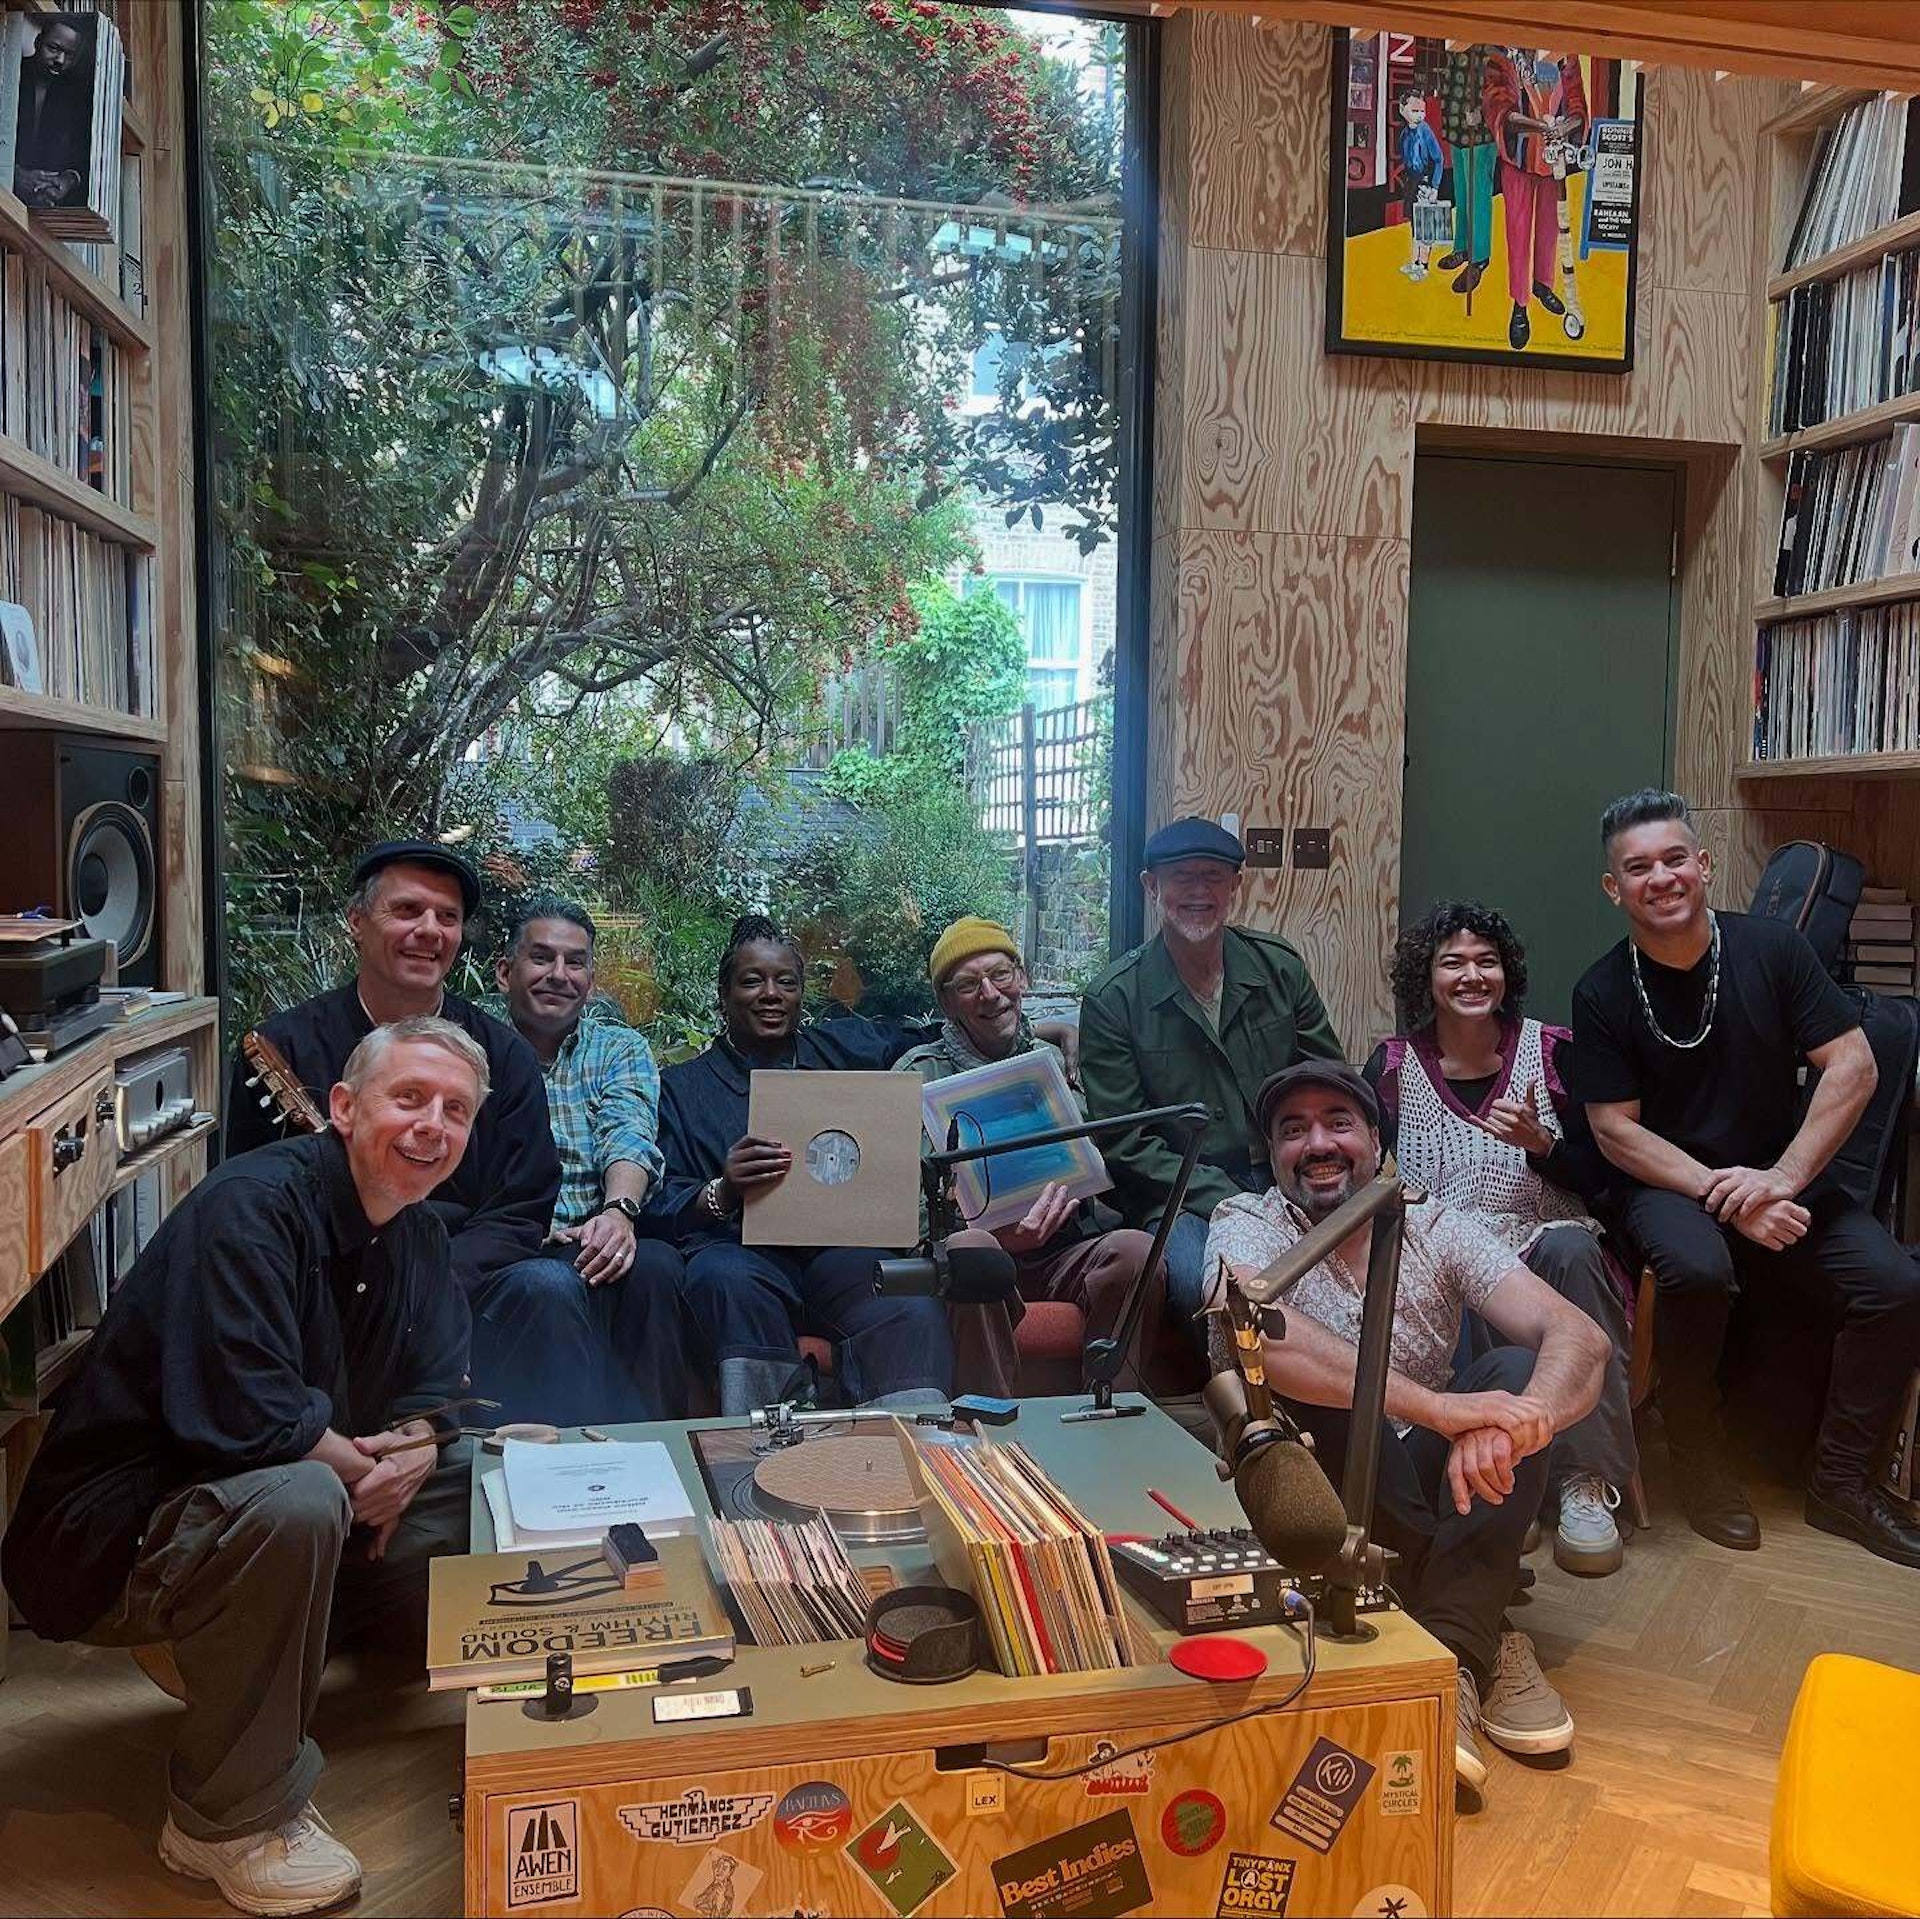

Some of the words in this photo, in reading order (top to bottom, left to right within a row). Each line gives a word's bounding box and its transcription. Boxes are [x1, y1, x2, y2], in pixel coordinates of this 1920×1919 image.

[1602, 158, 1622, 169] JON
[564, 1623, 580, 1633] &
[591, 1612, 698, 1633] RHYTHM
[461, 1627, 553, 1644] SOUND
[462, 1621, 702, 1661] FREEDOM
[660, 1799, 734, 1820] HERMANOS
[975, 1794, 996, 1806] LEX
[651, 1813, 742, 1838] GUTIERREZ
[515, 1849, 571, 1878] AWEN
[1000, 1867, 1060, 1907] Best
[1058, 1839, 1136, 1881] Indies
[514, 1879, 572, 1898] ENSEMBLE
[1227, 1868, 1289, 1892] LAST
[1223, 1887, 1286, 1910] ORGY
